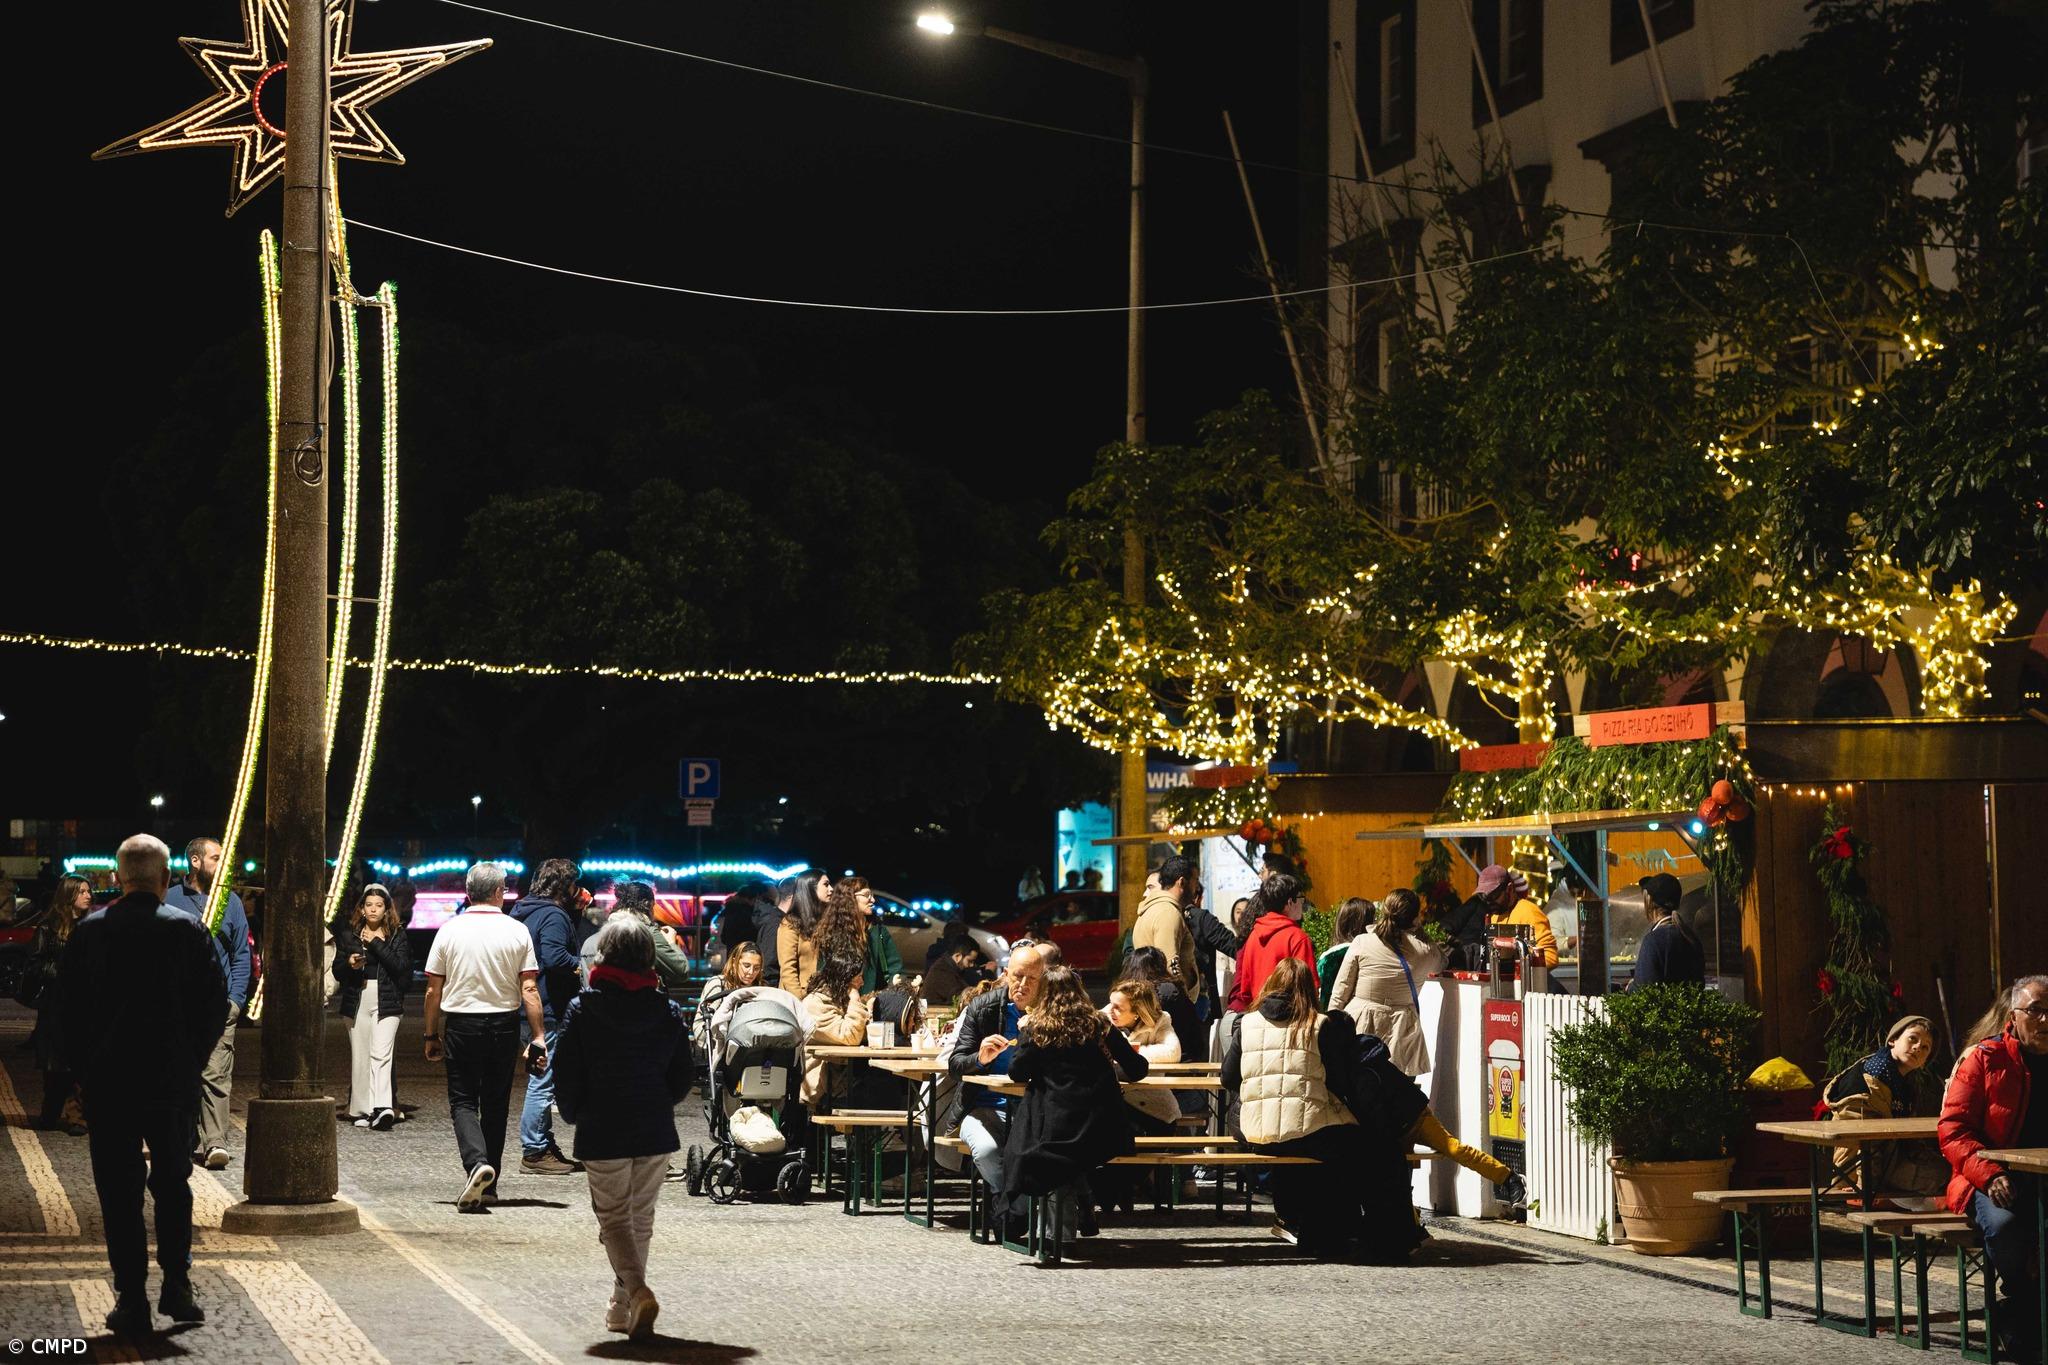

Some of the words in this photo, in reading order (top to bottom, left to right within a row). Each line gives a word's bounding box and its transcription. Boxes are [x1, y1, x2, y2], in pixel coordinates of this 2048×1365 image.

[1645, 715, 1659, 734] DO
[689, 763, 711, 795] P
[1147, 772, 1194, 788] WHA
